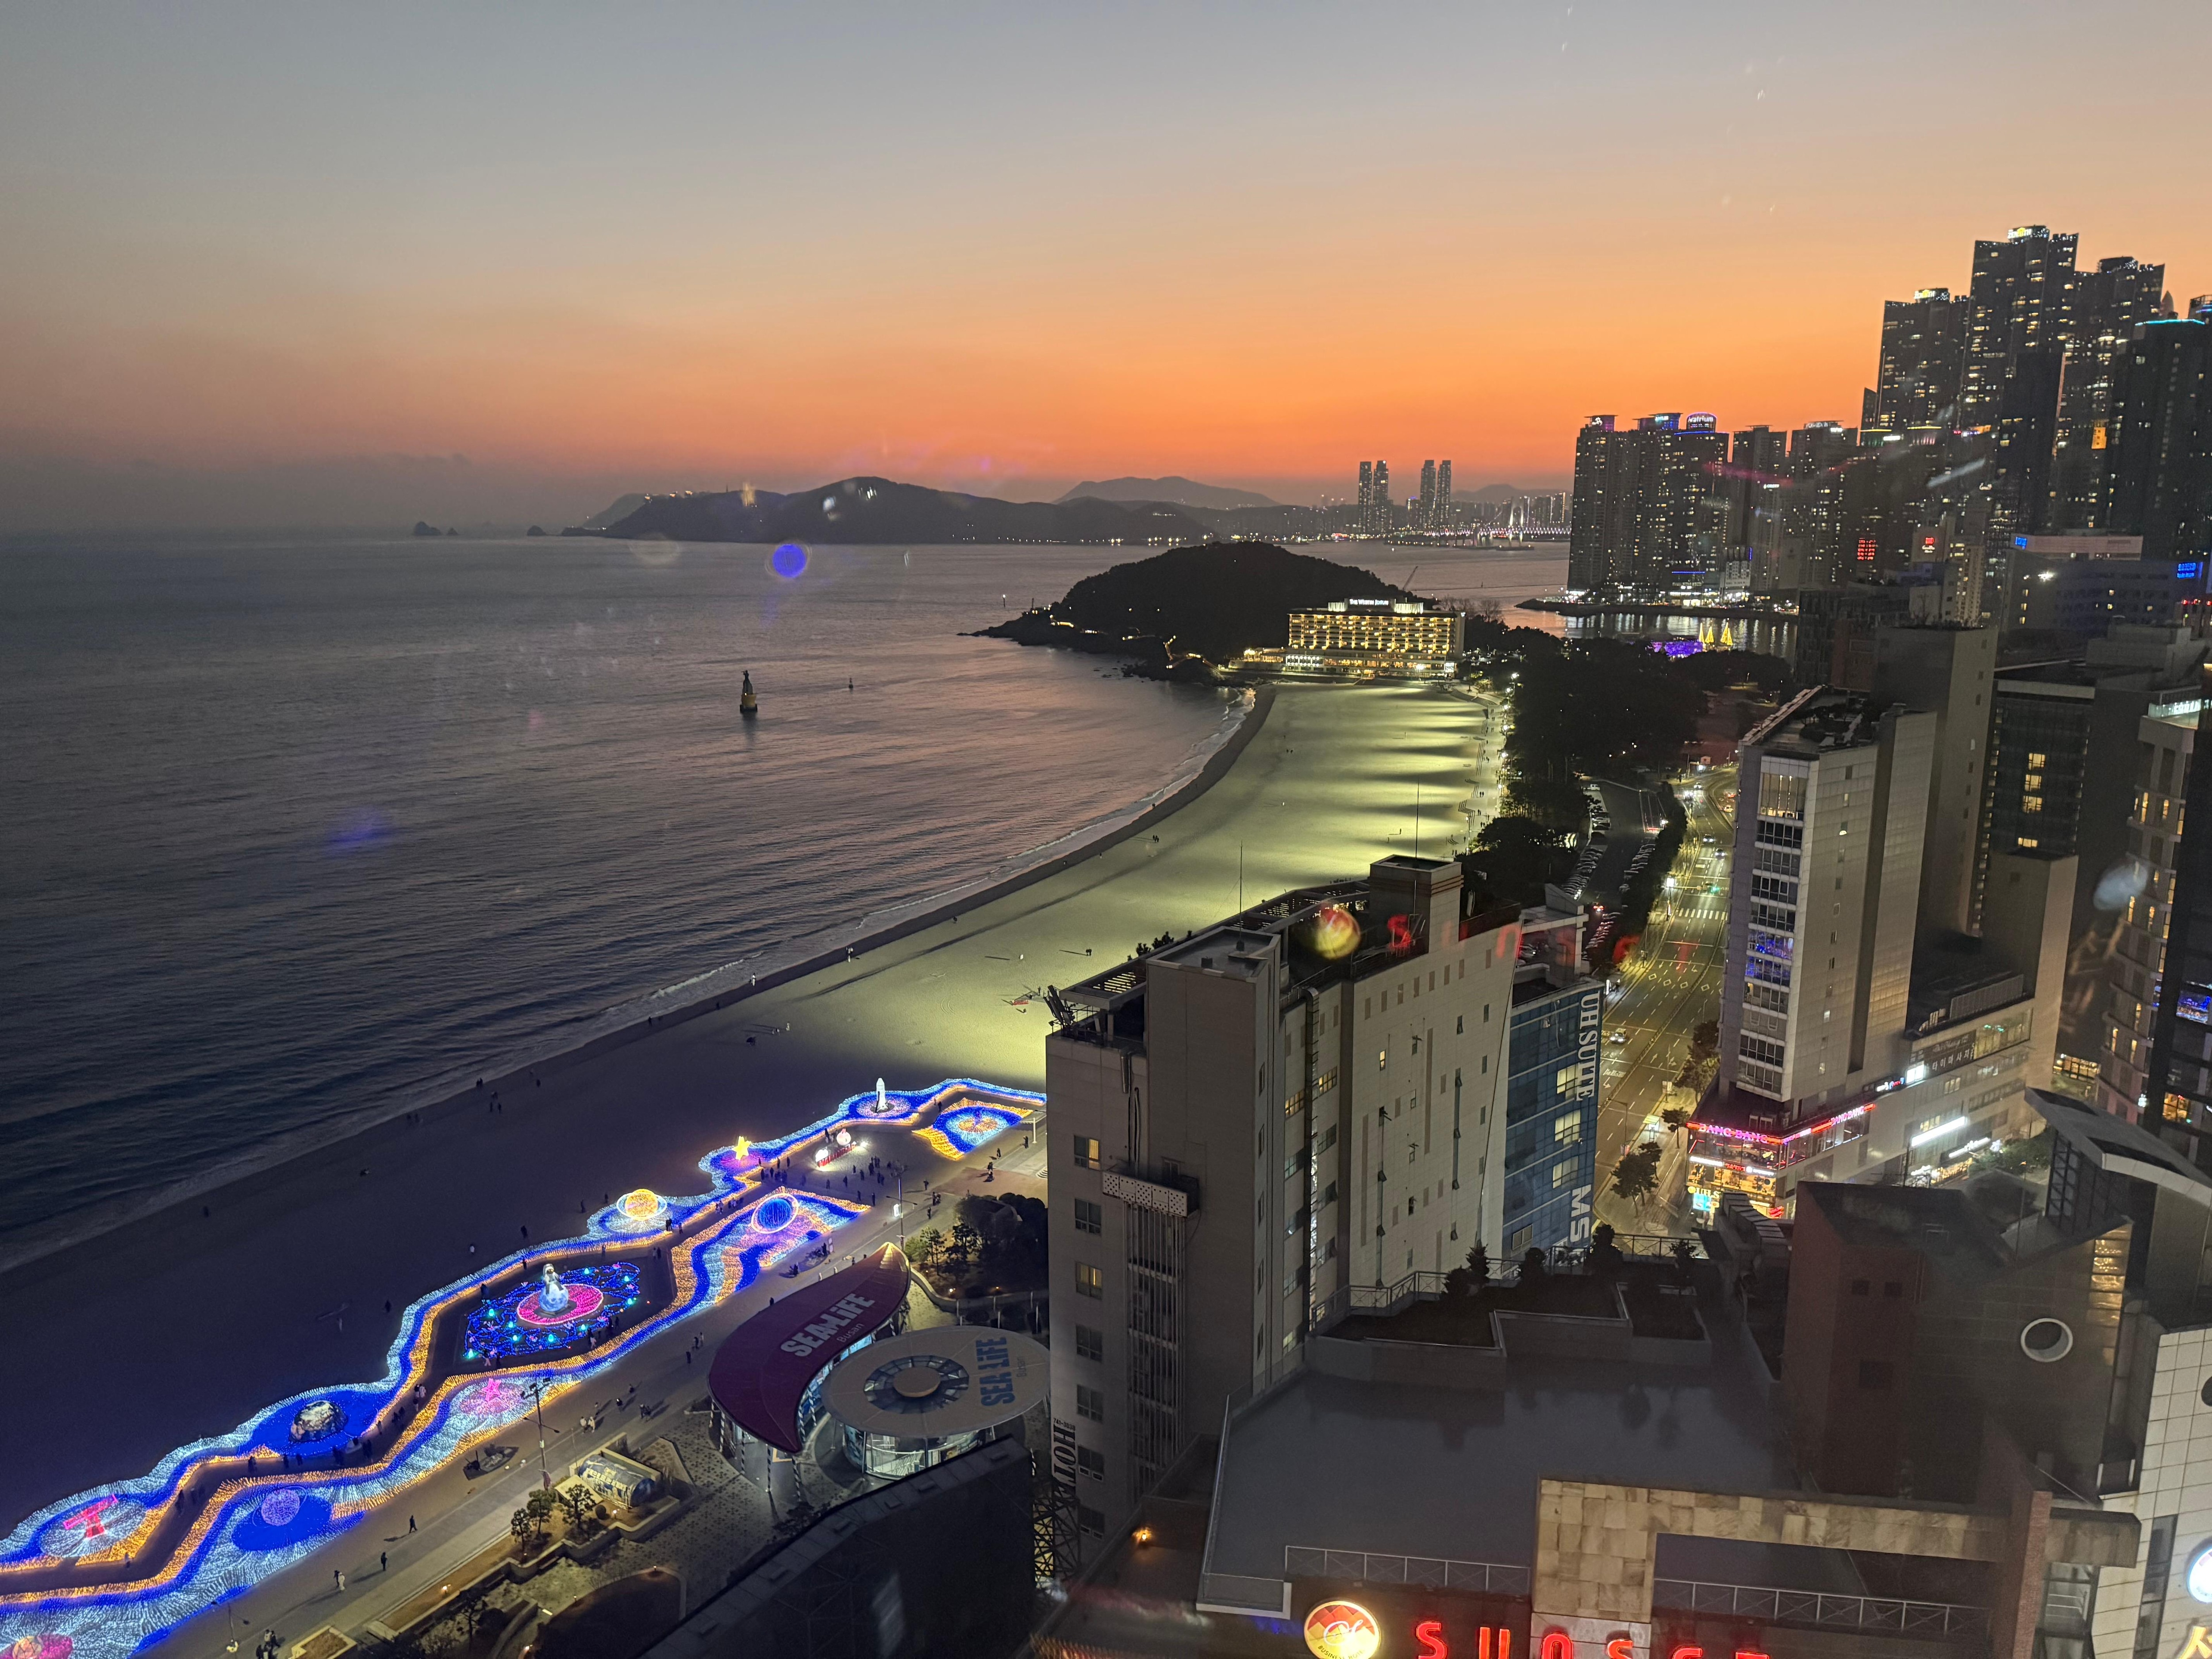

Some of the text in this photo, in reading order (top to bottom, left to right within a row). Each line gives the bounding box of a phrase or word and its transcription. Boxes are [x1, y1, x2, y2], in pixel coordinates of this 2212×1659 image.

[1576, 990, 1600, 1102] UH SUITE
[1698, 1123, 1732, 1137] BANG
[1735, 1130, 1769, 1144] BANG
[1570, 1184, 1592, 1243] MS
[836, 1322, 865, 1343] Busan
[979, 1371, 1015, 1406] SEA
